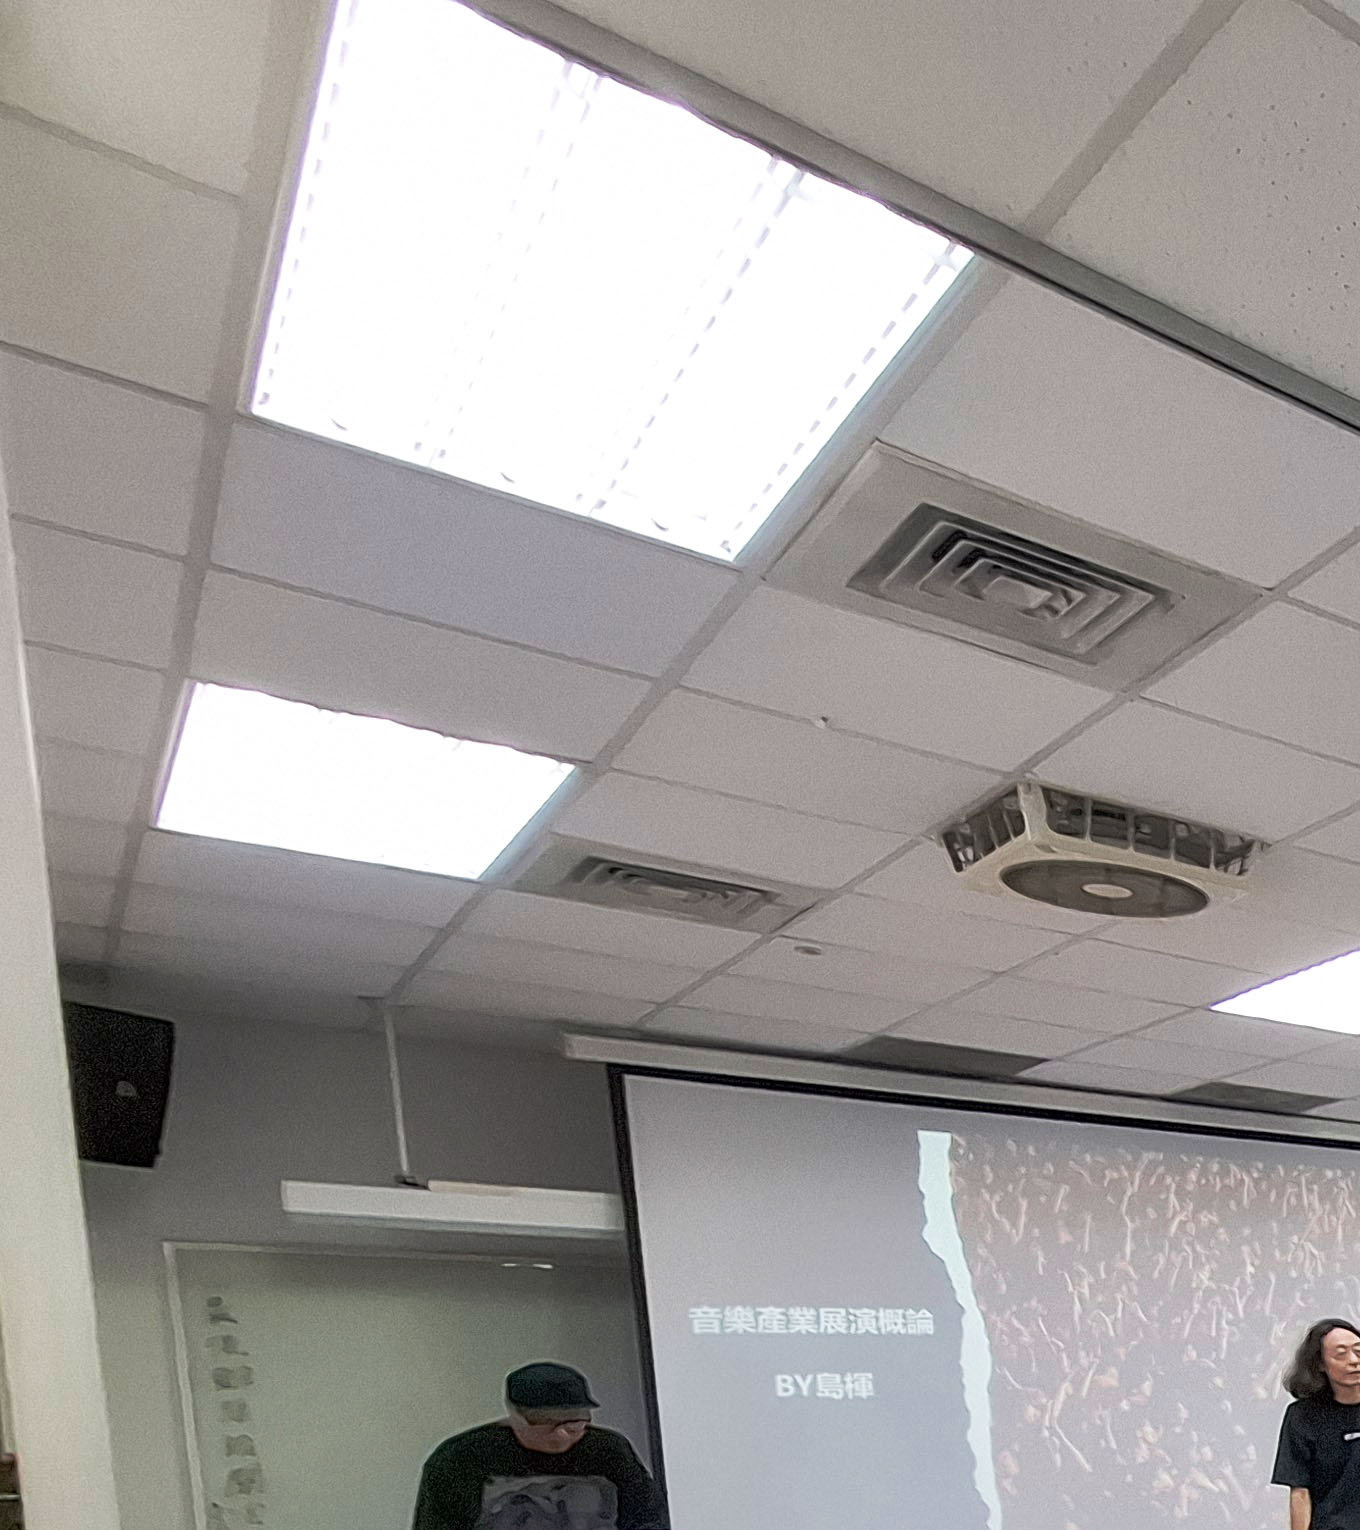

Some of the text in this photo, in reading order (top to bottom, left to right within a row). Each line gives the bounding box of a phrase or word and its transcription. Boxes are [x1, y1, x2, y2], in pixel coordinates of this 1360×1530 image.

[688, 1306, 935, 1335] 音樂產業展演概論
